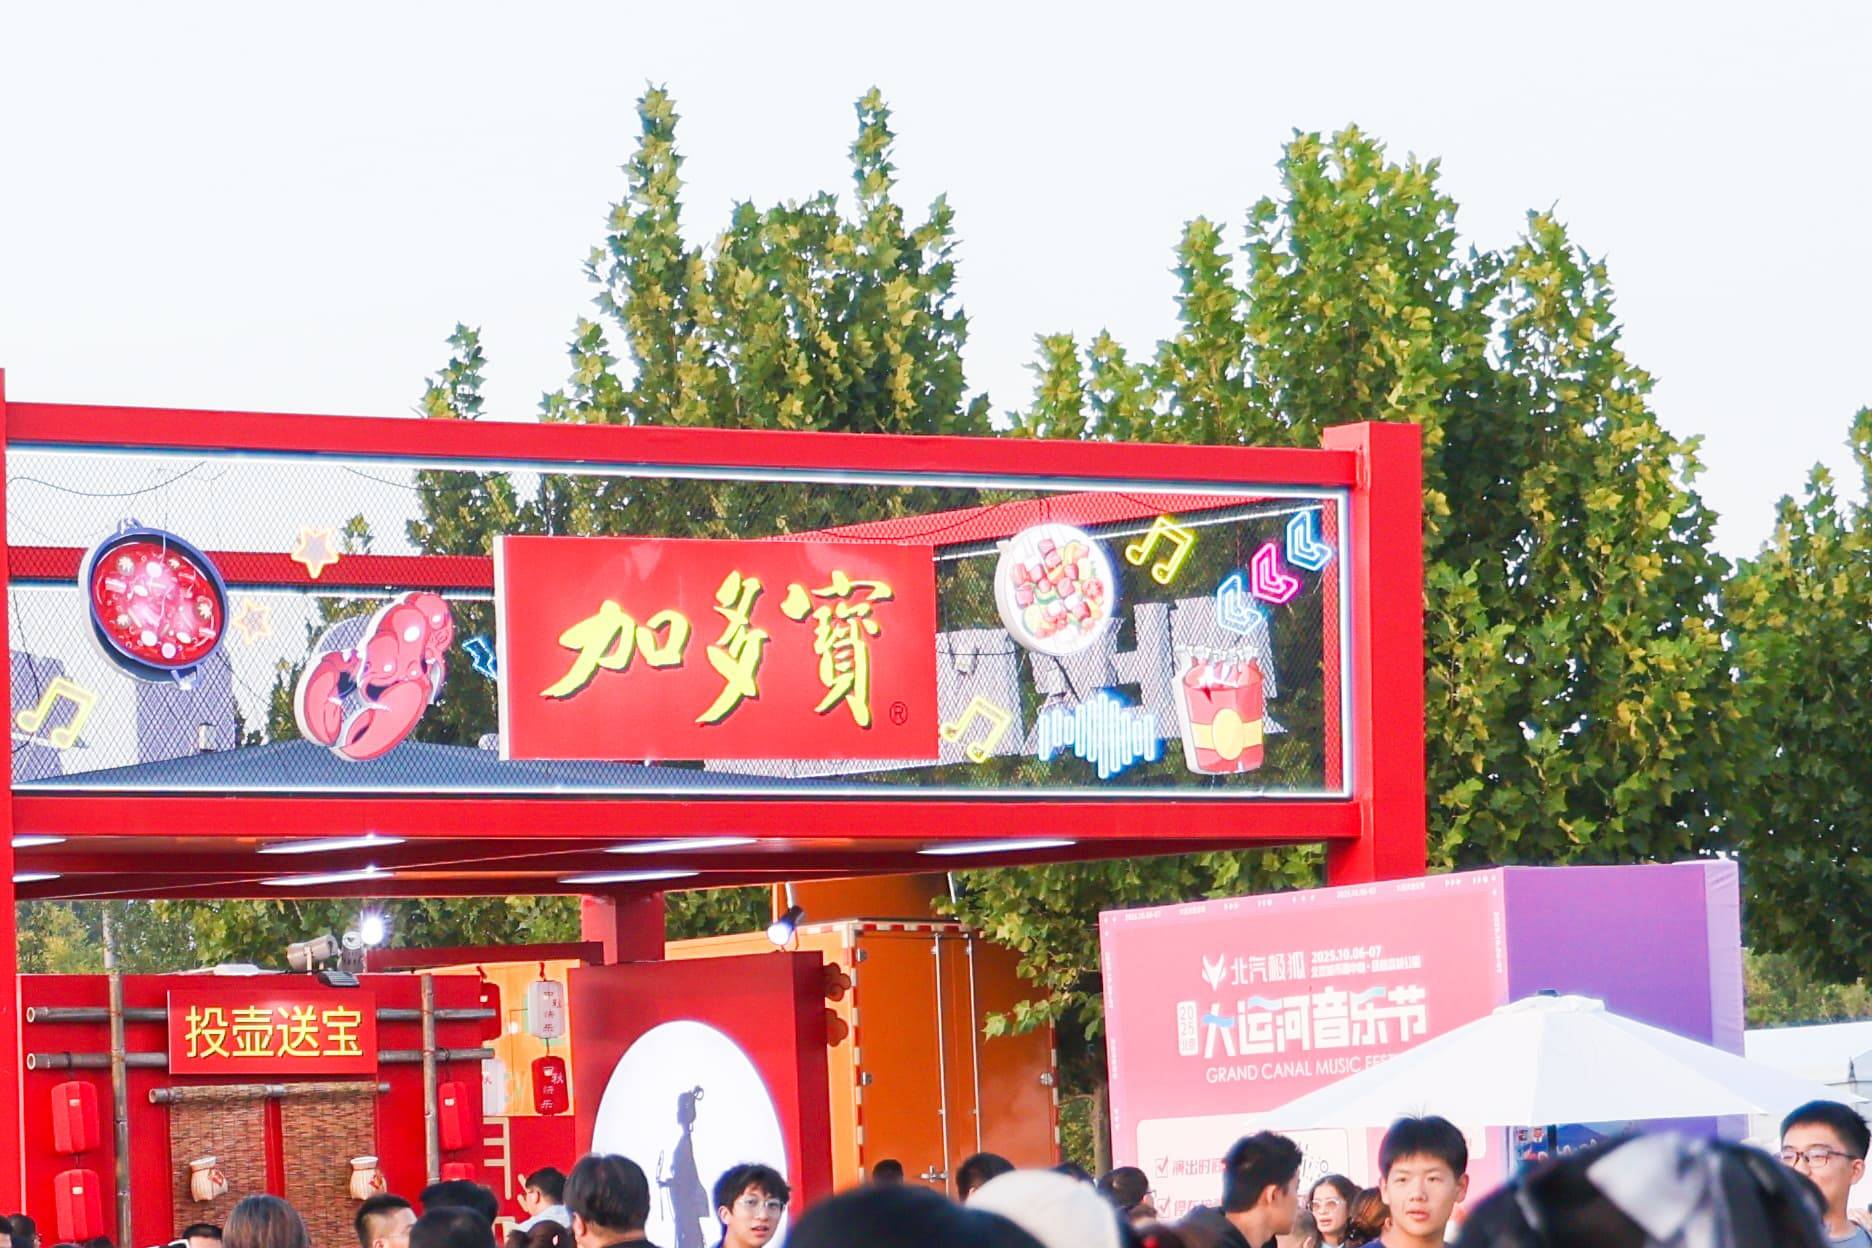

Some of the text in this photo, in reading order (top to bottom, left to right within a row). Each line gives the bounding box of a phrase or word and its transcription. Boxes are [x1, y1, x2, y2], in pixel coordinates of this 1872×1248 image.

[539, 568, 895, 732] 加多寶
[1231, 951, 1307, 985] 北汽极狐
[1311, 946, 1382, 964] 2025.10.06-07
[184, 1003, 365, 1060] 投壶送宝
[1202, 984, 1428, 1060] 大运河音乐节
[1206, 1065, 1259, 1084] GRAND
[1261, 1061, 1313, 1080] CANAL
[1316, 1056, 1361, 1076] MUSIC
